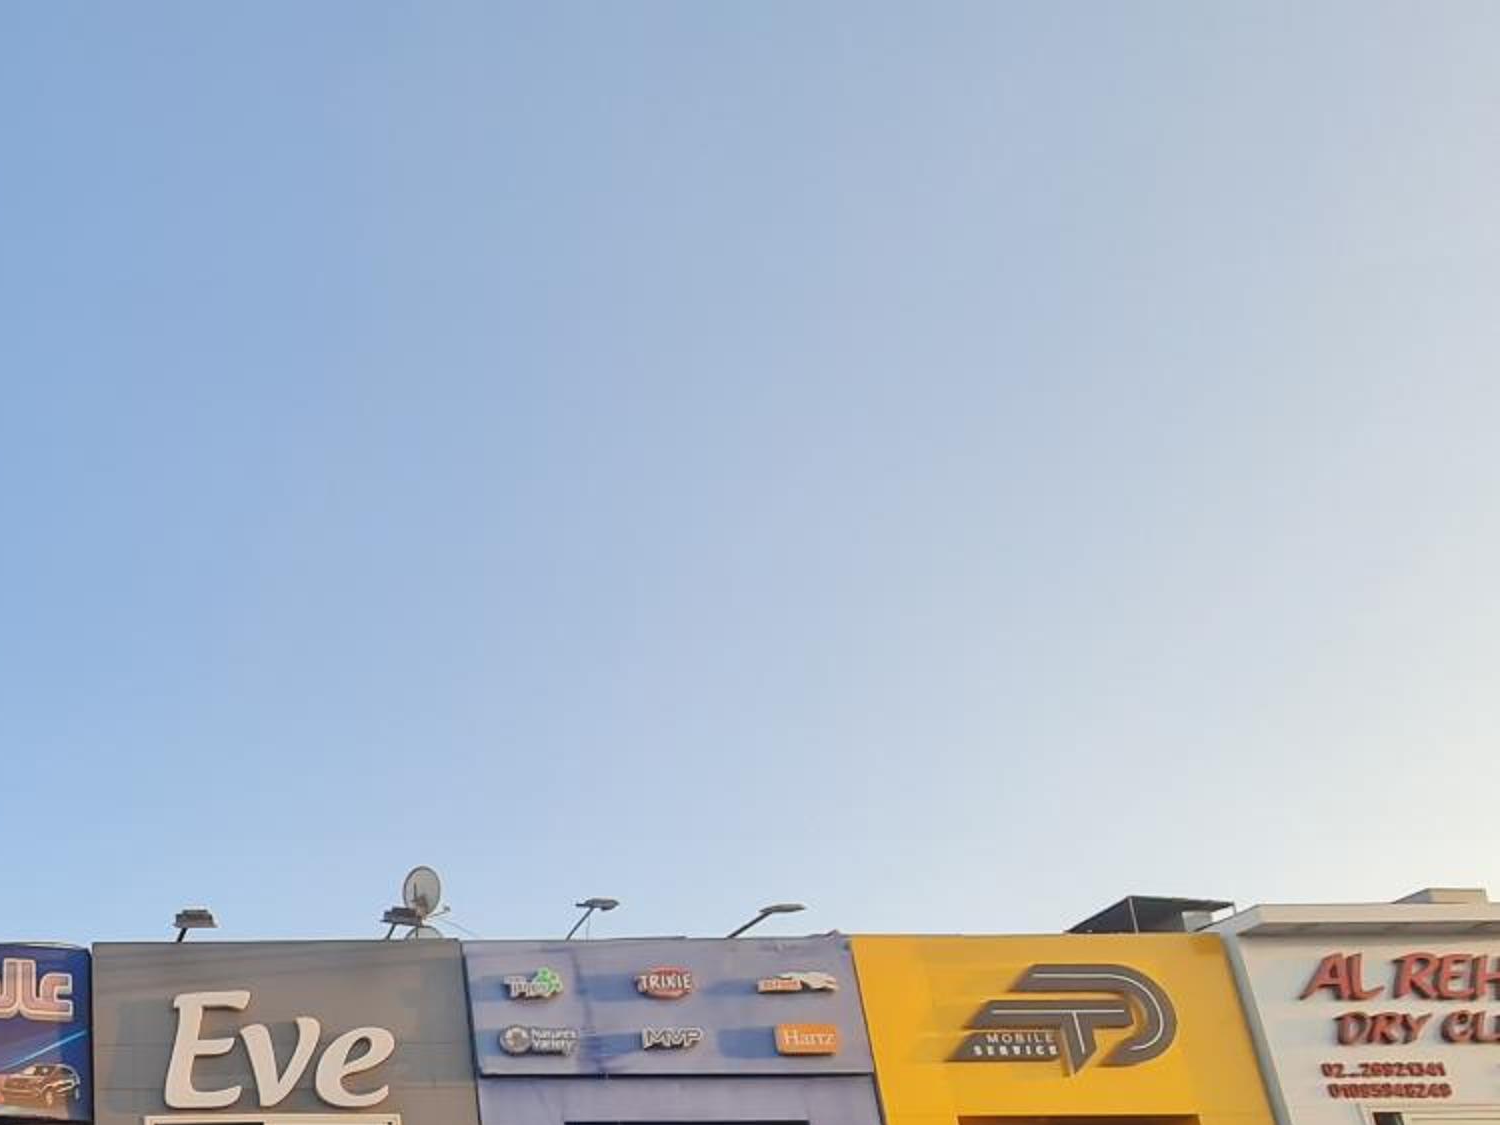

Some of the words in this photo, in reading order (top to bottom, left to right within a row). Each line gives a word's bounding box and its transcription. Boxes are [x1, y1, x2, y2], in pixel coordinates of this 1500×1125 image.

[636, 973, 693, 992] TRIXIE
[1298, 952, 1385, 1001] AL
[643, 1027, 703, 1048] MVP
[1333, 1011, 1433, 1045] DRY
[1440, 1009, 1500, 1045] CL
[985, 1032, 1054, 1044] MOBILE
[164, 990, 396, 1109] Eve
[972, 1045, 1059, 1056] SERVICE
